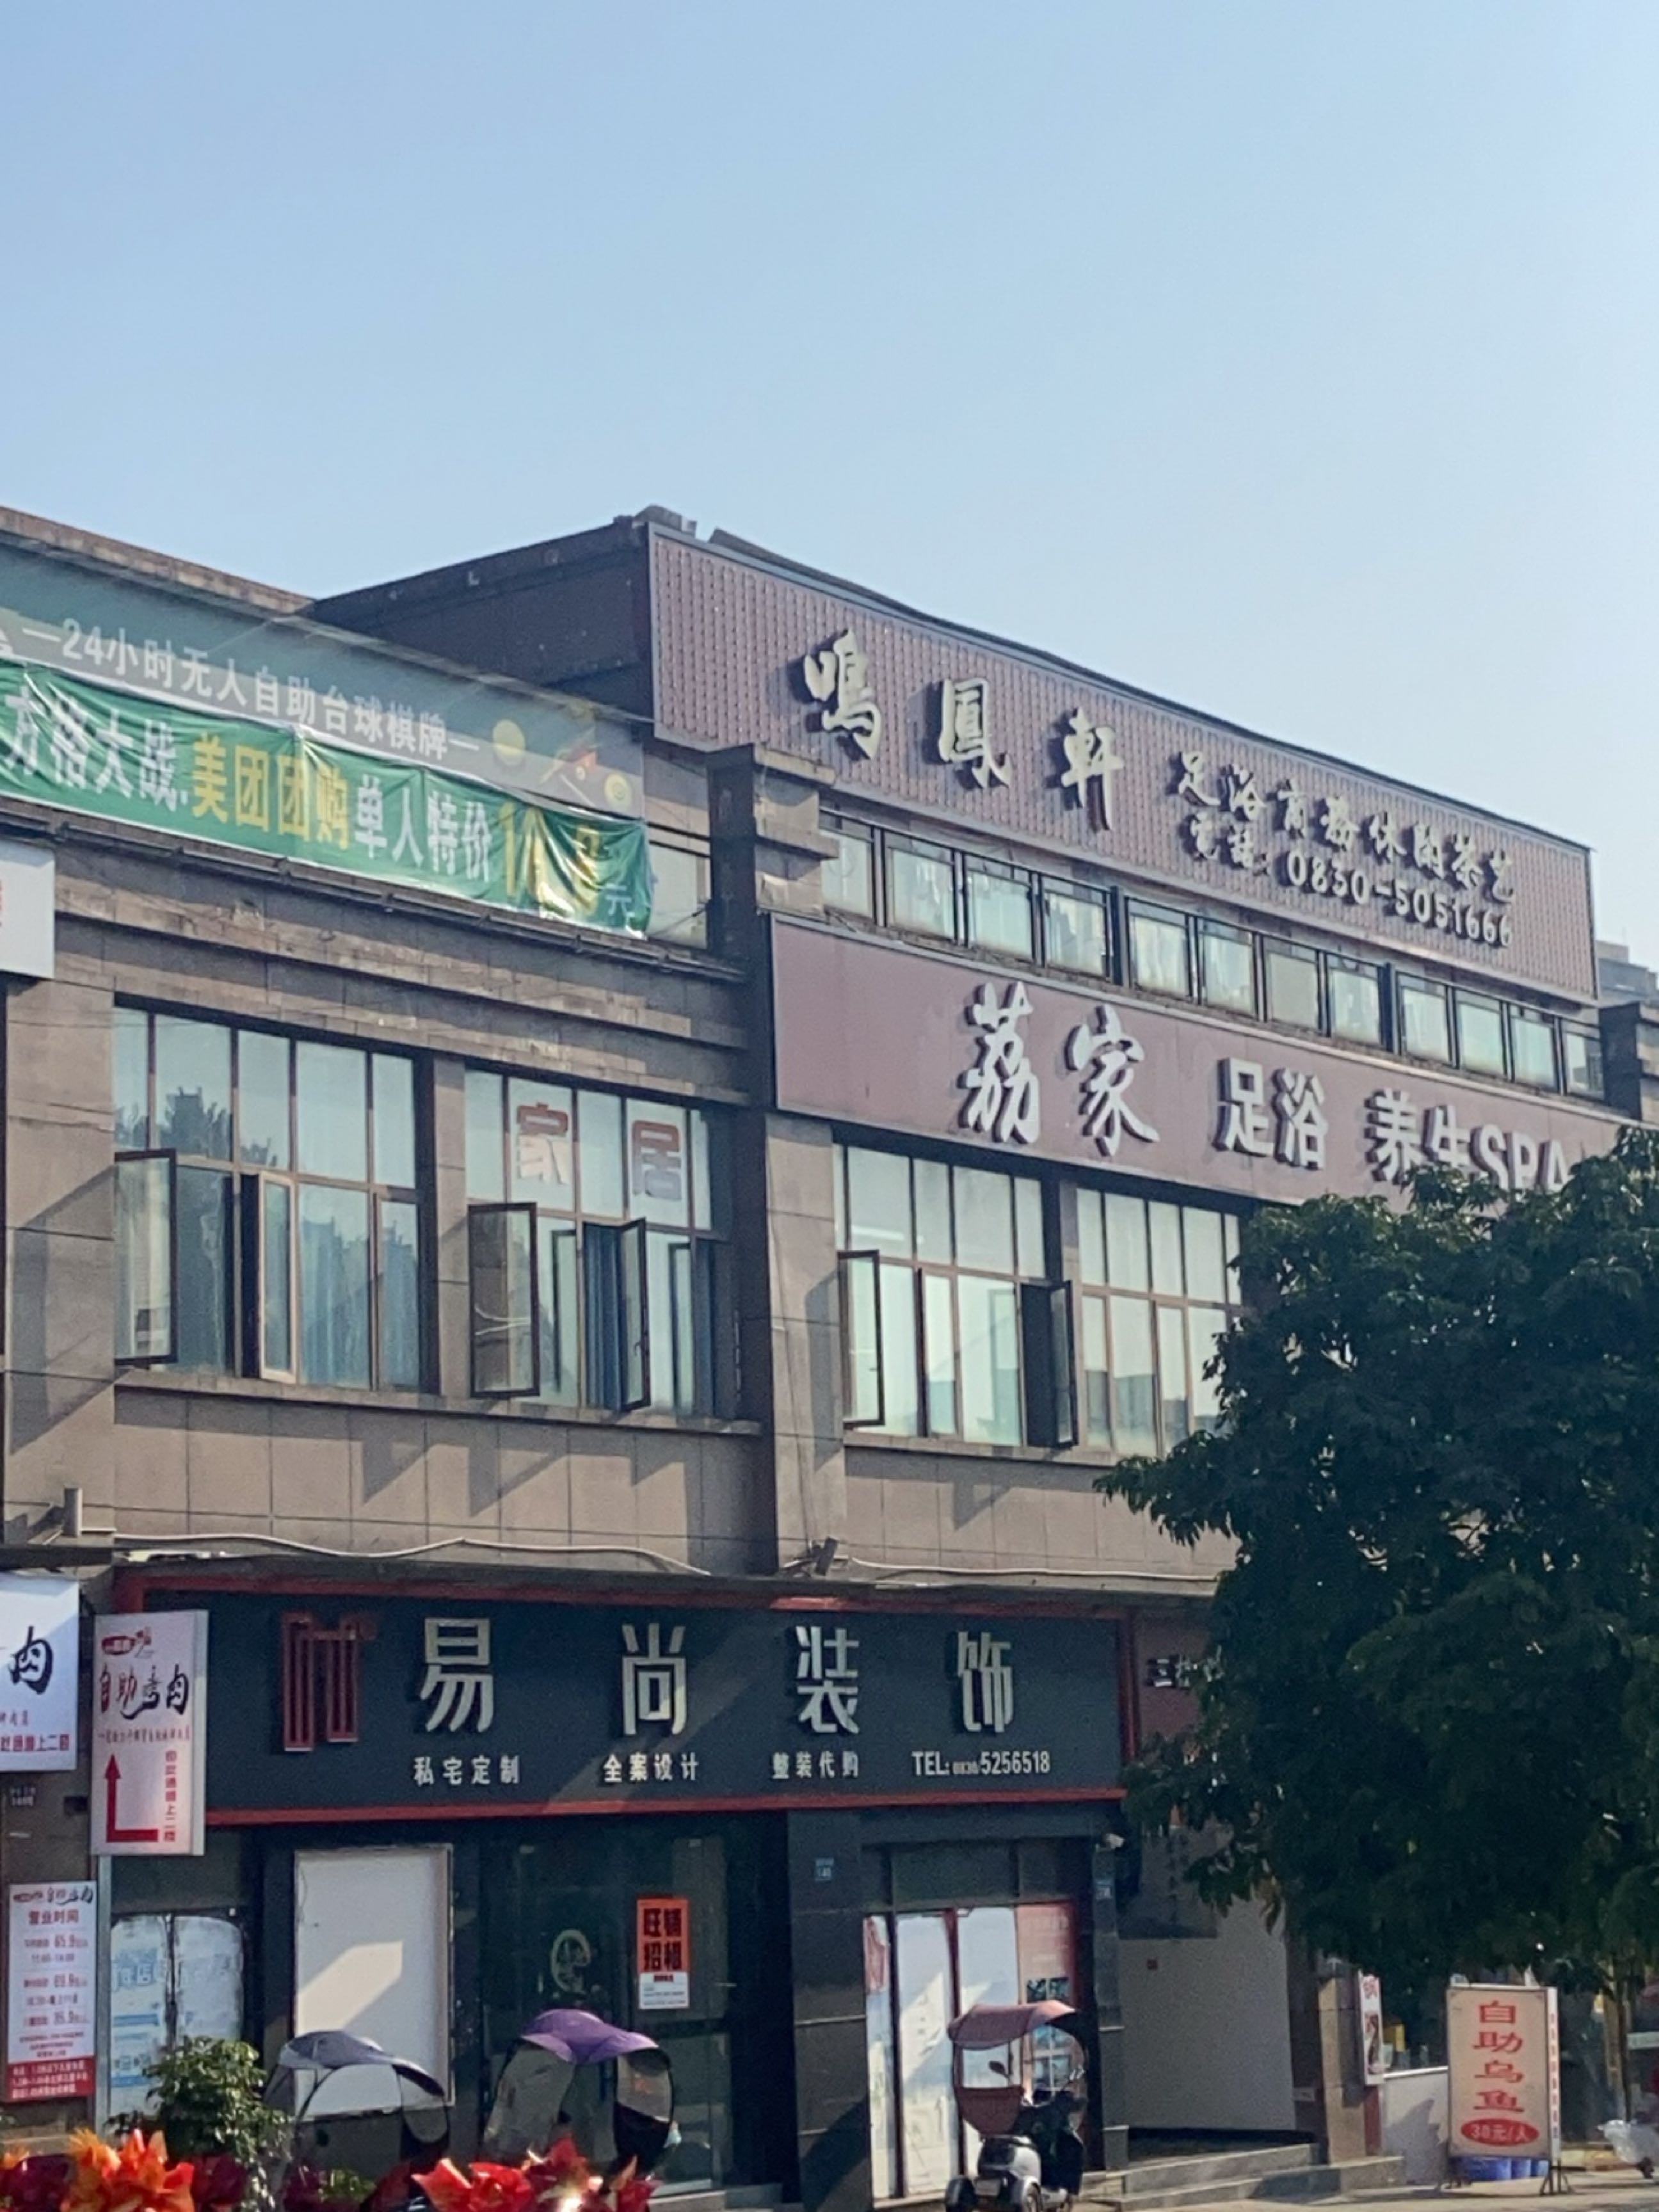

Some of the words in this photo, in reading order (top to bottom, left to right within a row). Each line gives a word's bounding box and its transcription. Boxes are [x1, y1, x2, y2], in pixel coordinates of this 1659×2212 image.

[1219, 1057, 1327, 1169] 足浴
[413, 1754, 521, 1787] 私宅定制
[602, 1752, 700, 1783] 全案设计
